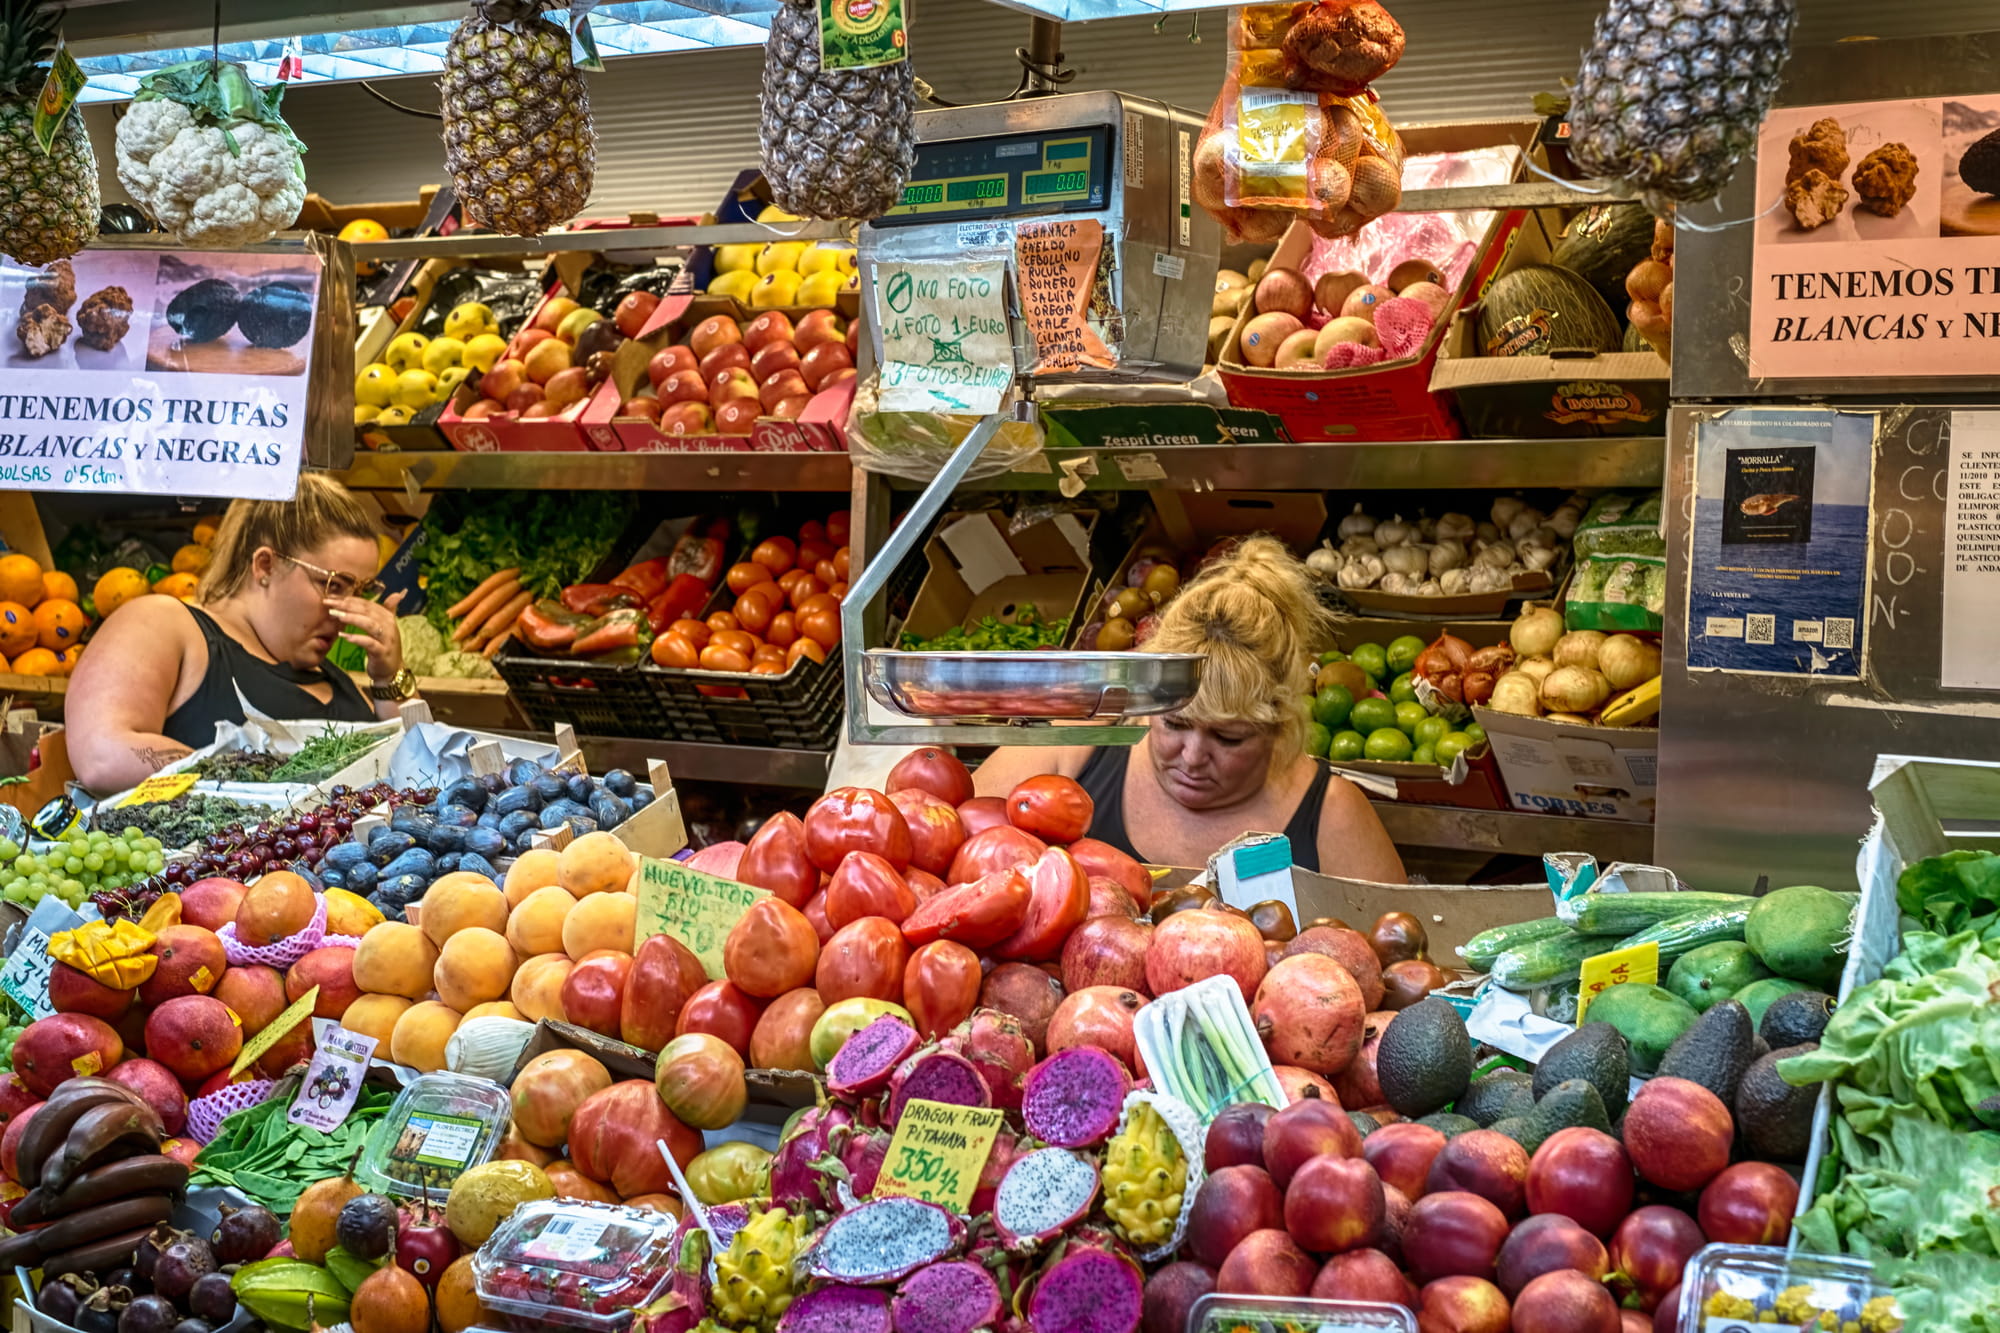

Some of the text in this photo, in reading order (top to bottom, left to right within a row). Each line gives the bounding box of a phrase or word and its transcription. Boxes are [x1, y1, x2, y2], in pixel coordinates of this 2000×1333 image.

[894, 30, 903, 47] 6
[976, 180, 1004, 199] 0.00
[1056, 172, 1086, 191] 0.00
[917, 278, 990, 299] NO FOTO
[1771, 267, 1954, 300] TENEMOS
[904, 314, 941, 335] FOTO
[1037, 317, 1069, 329] KALE
[1771, 312, 1928, 342] BLANCAS
[1936, 319, 1954, 338] Y
[0, 395, 289, 428] TENEMOS TRUFAS
[1566, 398, 1628, 411] BOLLO
[1102, 433, 1200, 447] Zespri Green
[1225, 425, 1259, 438] reen
[0, 434, 282, 466] BLANCAS Y NEGRAS
[1961, 451, 1973, 459] SE
[1960, 472, 1988, 480] 11/2010
[1959, 482, 1981, 490] ESTE
[1956, 564, 1968, 572] DE
[1514, 792, 1617, 815] TORRES
[904, 1105, 958, 1126] DRAGON
